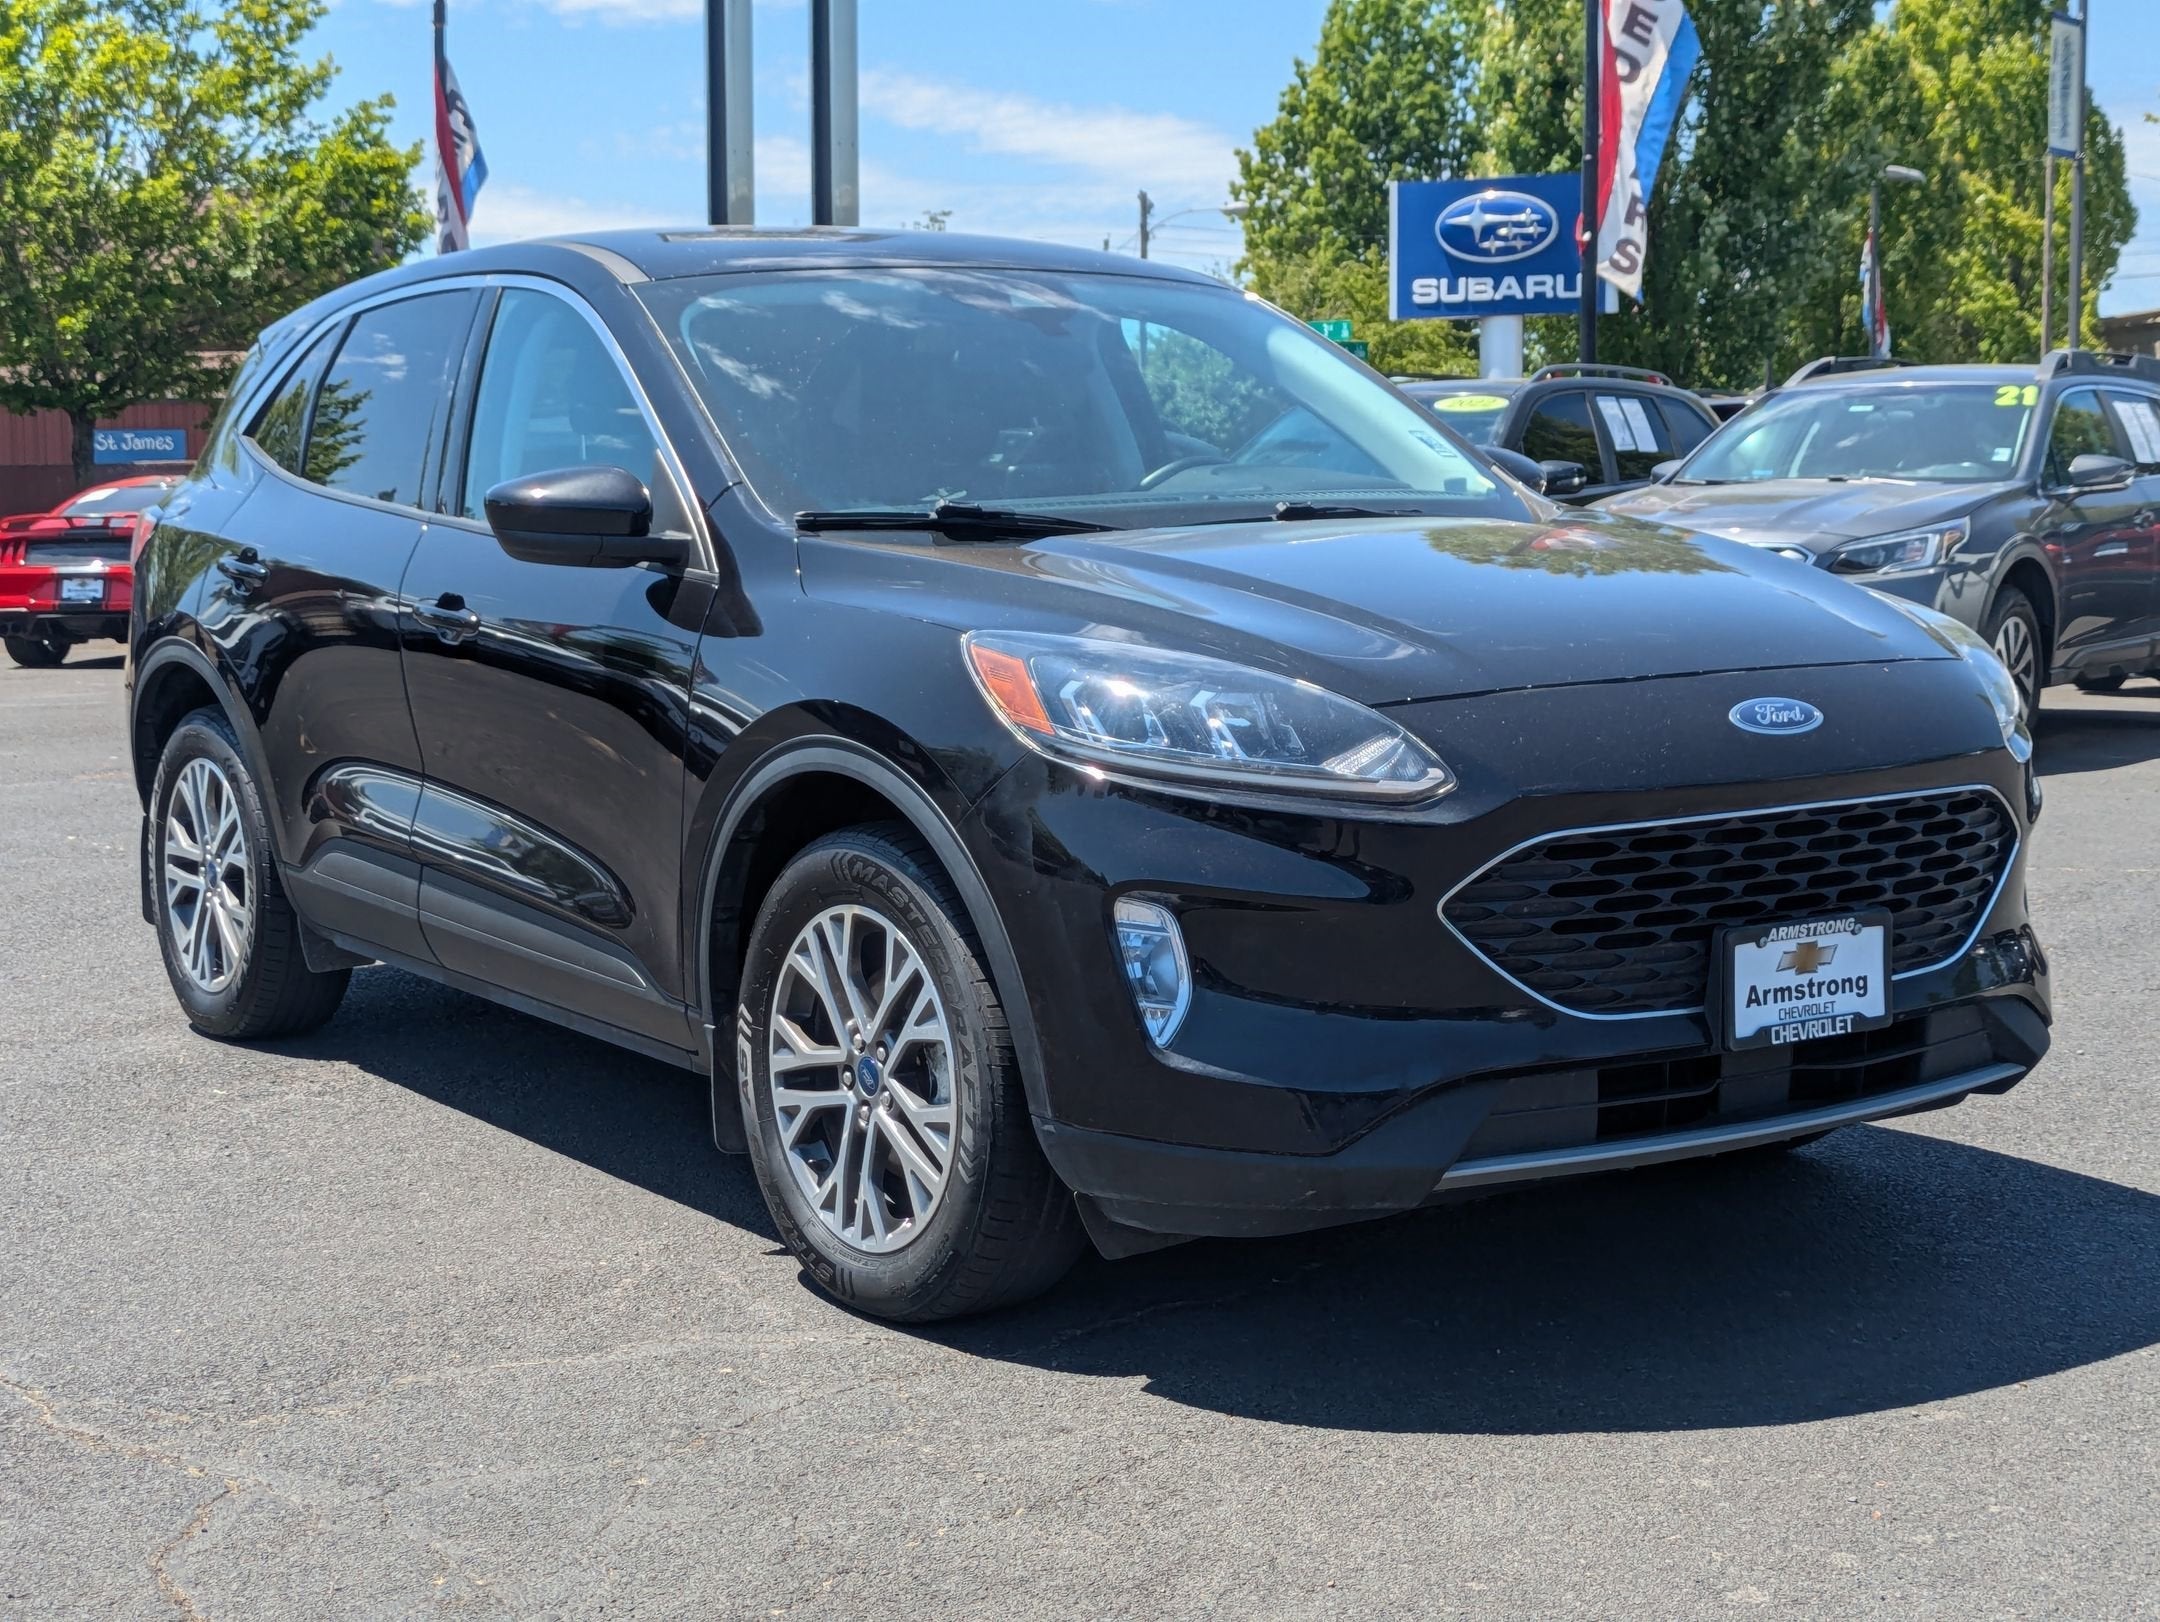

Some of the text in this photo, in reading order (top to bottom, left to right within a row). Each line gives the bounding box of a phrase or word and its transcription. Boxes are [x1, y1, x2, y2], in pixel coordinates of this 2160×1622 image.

[1412, 272, 1582, 304] SUBARU
[1994, 385, 2039, 407] 21
[121, 432, 174, 451] James
[1754, 703, 1805, 725] Ford
[1767, 917, 1856, 942] ARMSTRONG
[1745, 975, 1868, 1008] Armstrong
[1778, 1001, 1836, 1021] CHEVROLET
[1771, 1015, 1854, 1045] CHEVROLET
